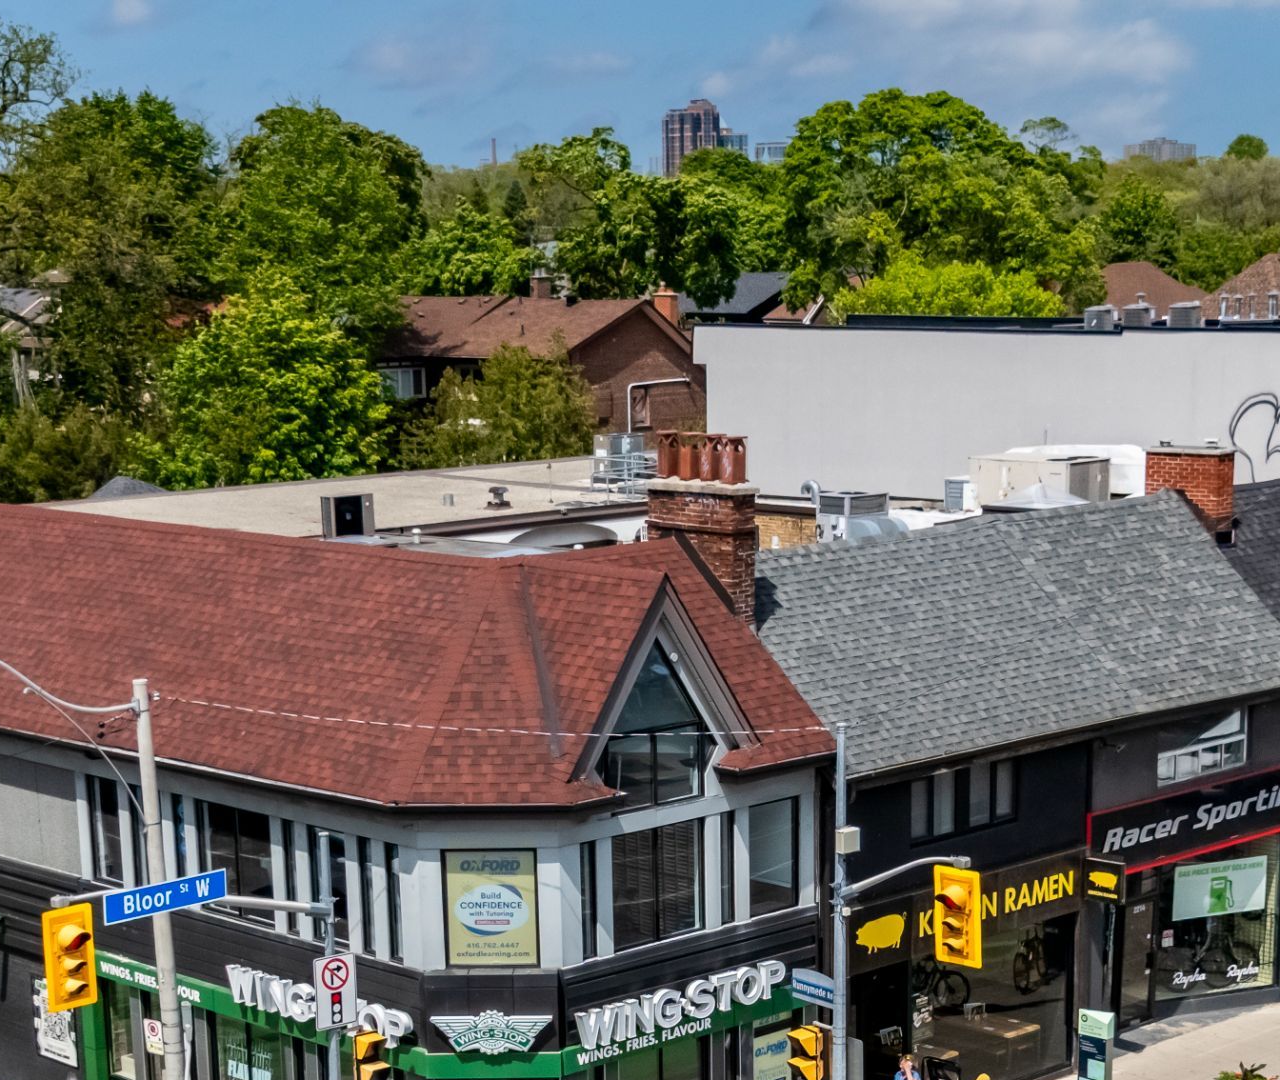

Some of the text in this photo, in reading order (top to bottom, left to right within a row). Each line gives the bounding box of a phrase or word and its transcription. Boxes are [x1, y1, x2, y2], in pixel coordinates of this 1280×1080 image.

[1102, 813, 1189, 854] Racer
[123, 877, 210, 915] Bloor St W
[480, 892, 501, 900] Build
[1004, 870, 1074, 914] RAMEN
[460, 901, 522, 910] CONFIDENCE
[456, 950, 530, 958] oxfordlearning.com
[1172, 968, 1207, 989] Rapha
[1226, 961, 1259, 982] Rapha
[577, 1017, 712, 1066] WINGS. FRIES. FLAVOUR
